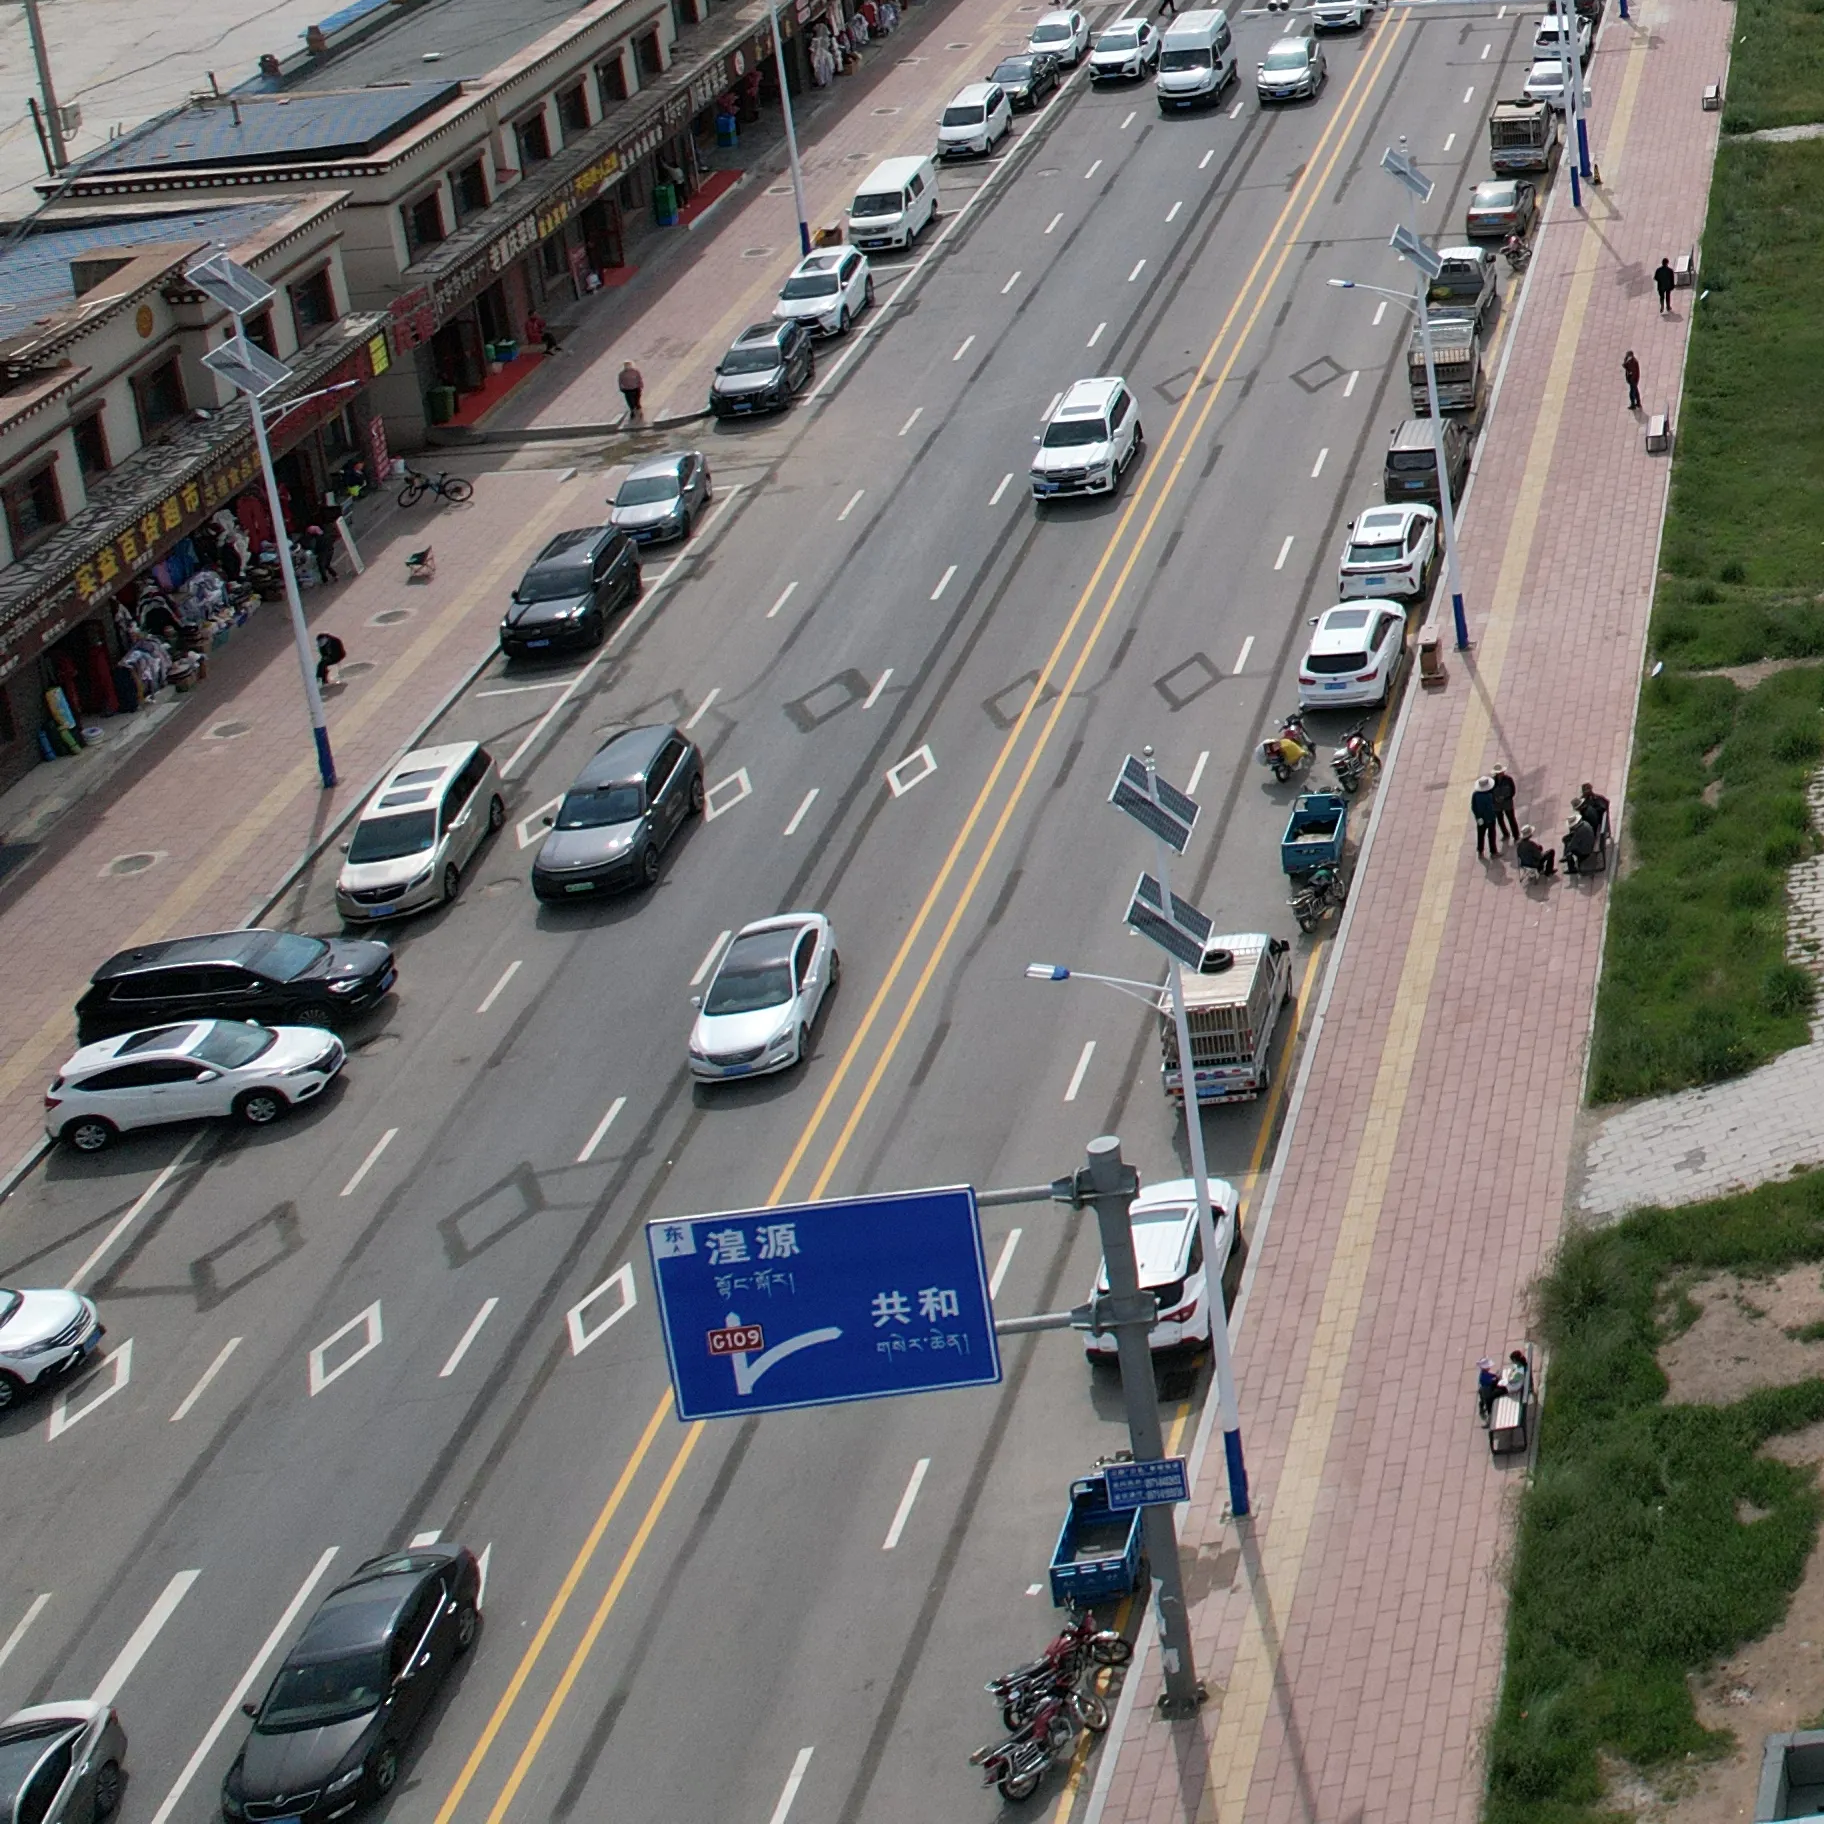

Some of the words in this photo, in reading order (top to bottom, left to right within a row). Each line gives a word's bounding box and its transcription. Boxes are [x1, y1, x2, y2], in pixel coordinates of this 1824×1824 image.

[664, 1226, 684, 1243] 东
[705, 1223, 800, 1265] 湟源
[871, 1287, 960, 1328] 共和
[712, 1329, 760, 1349] G109
